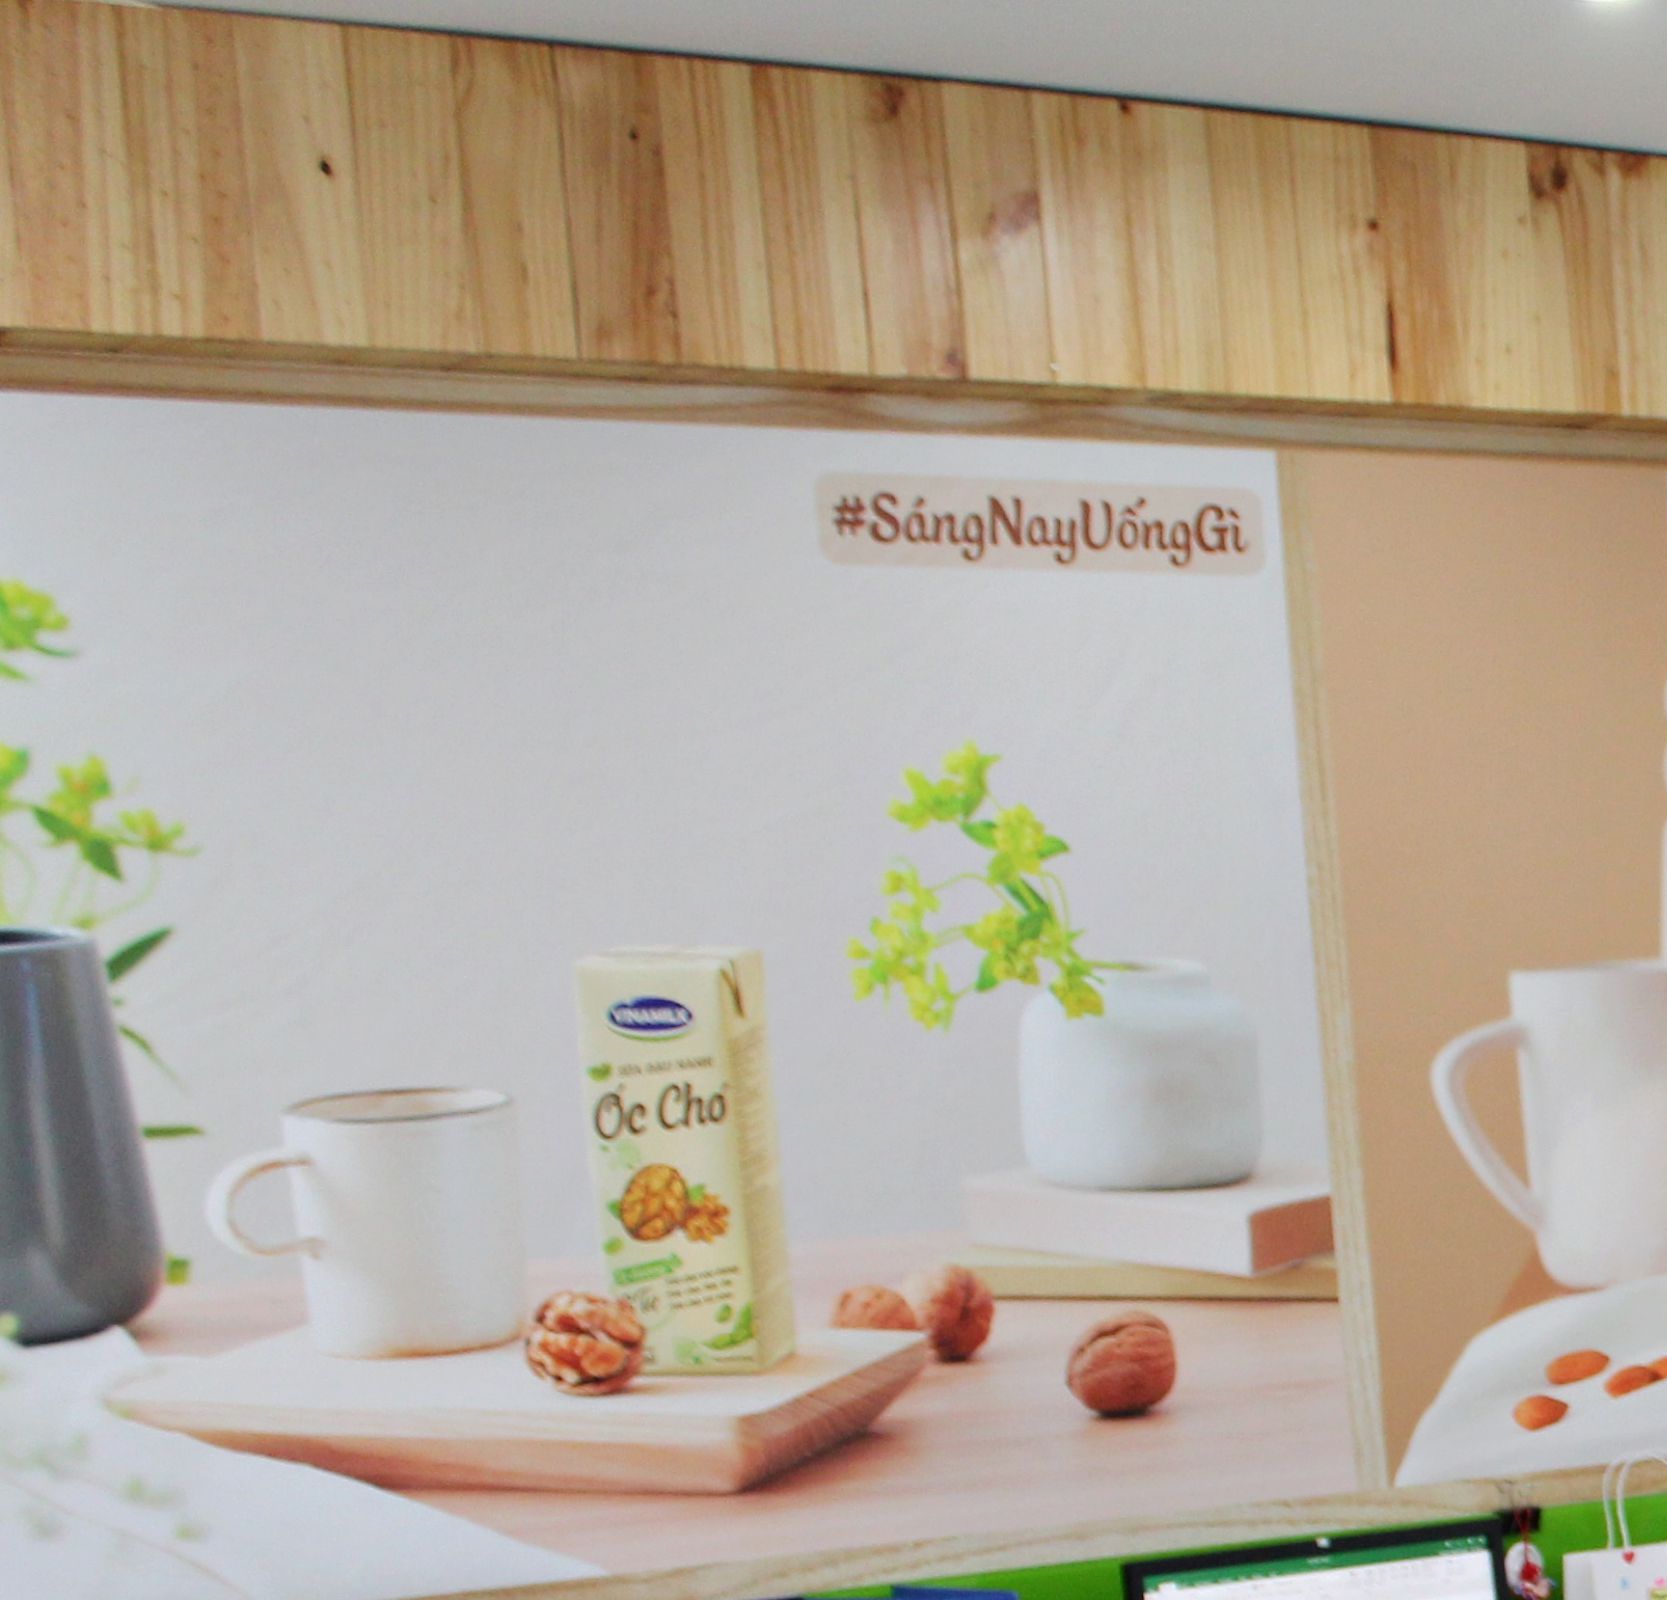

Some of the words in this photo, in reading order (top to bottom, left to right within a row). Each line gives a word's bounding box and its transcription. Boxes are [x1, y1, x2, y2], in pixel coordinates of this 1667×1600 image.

[833, 492, 1248, 567] #SángNayUốngGì
[595, 1083, 647, 1140] Óc
[658, 1081, 731, 1131] Chó
